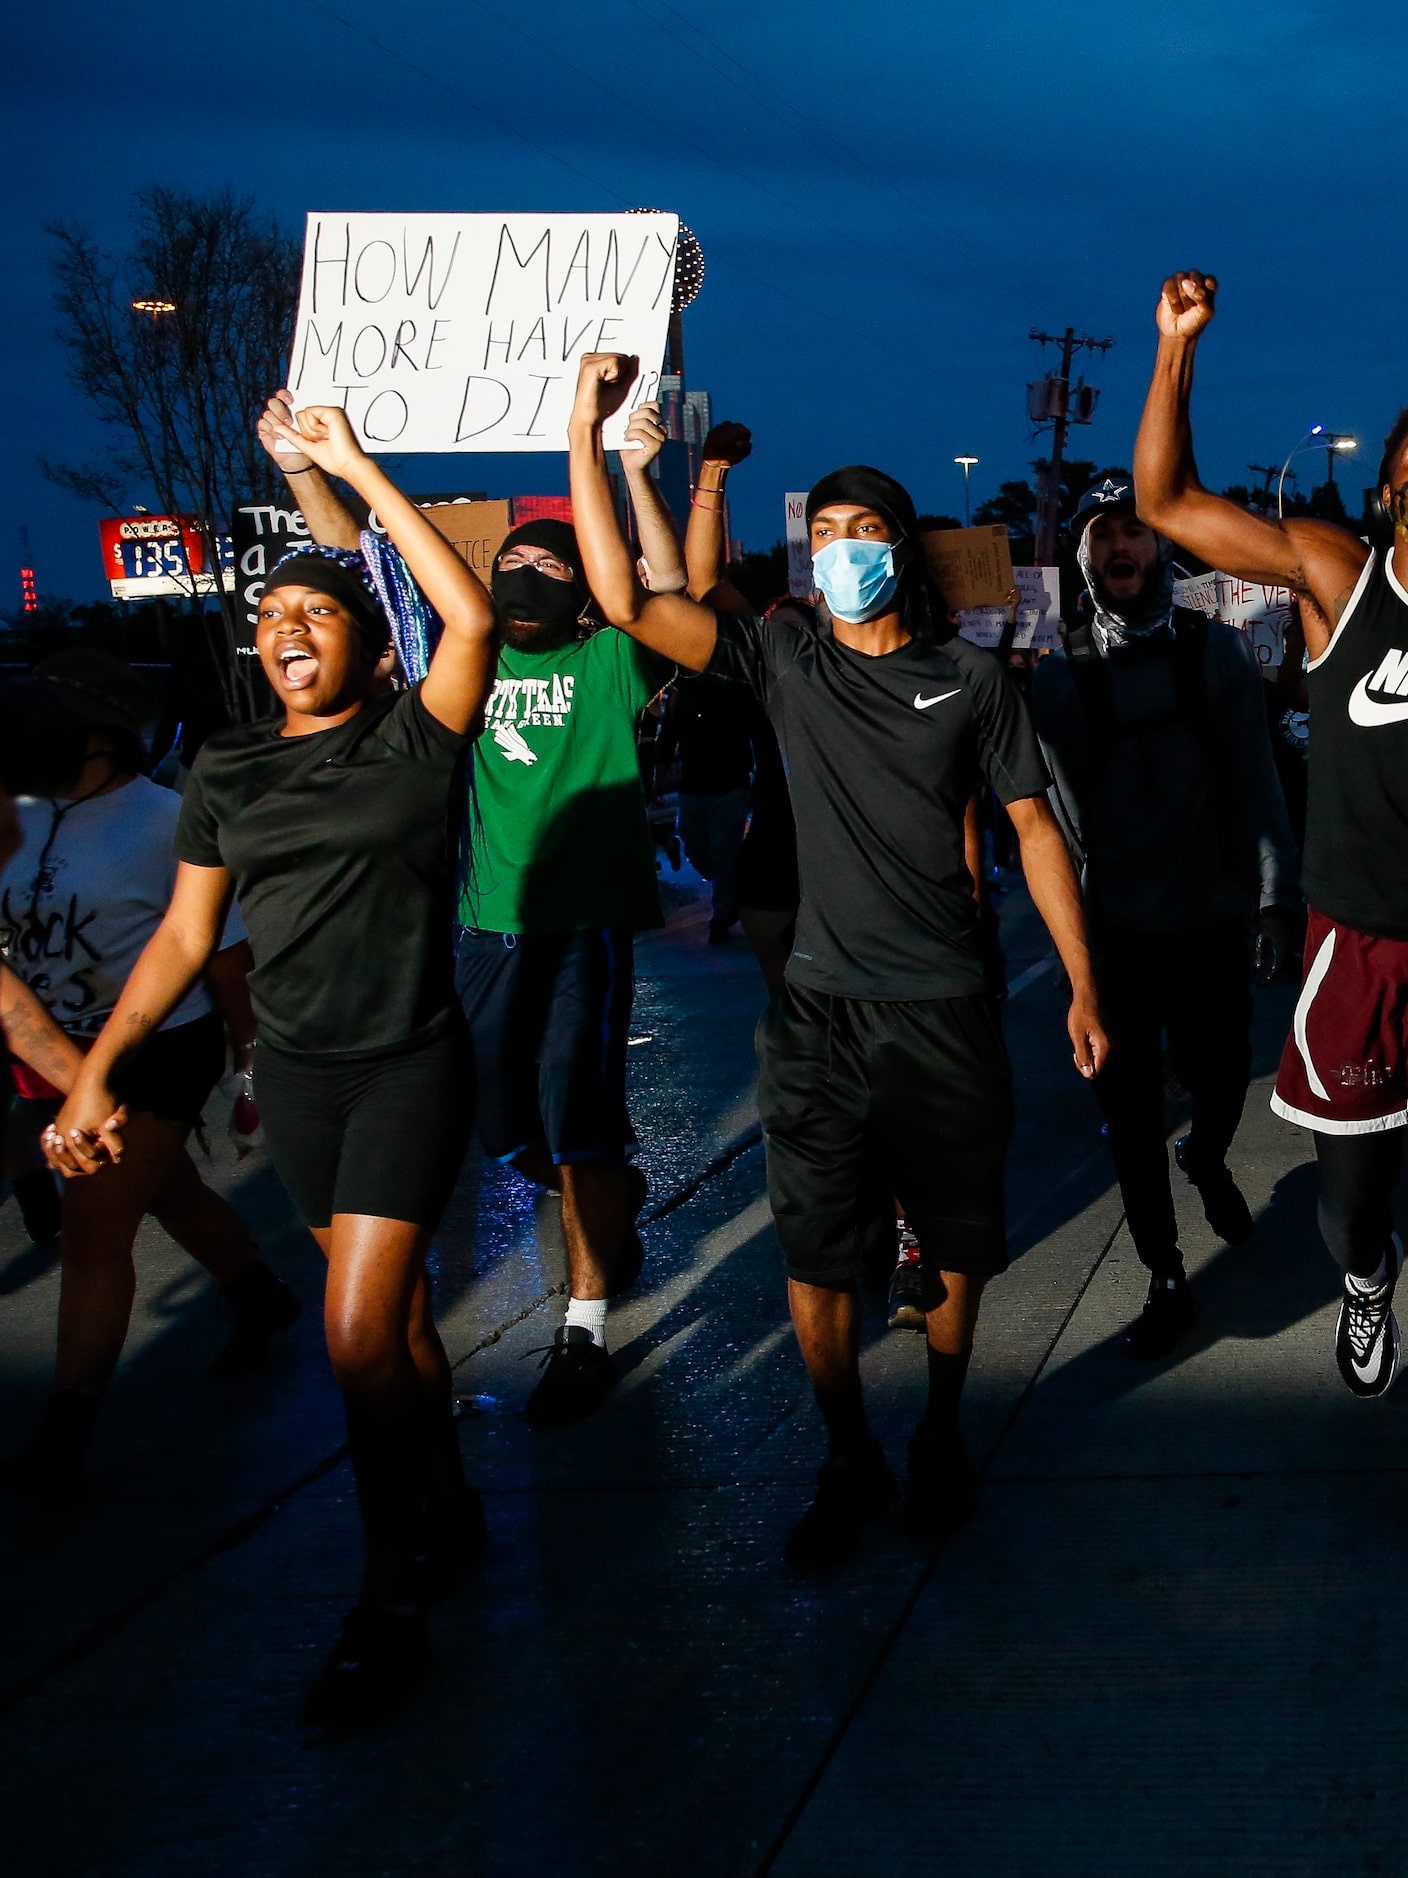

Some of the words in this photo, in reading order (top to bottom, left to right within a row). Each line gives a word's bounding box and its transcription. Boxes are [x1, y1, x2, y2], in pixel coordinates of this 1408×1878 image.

[313, 222, 461, 314] HOW
[486, 223, 677, 315] MANY
[296, 319, 452, 390] MORE
[484, 316, 624, 370] HAVE
[332, 385, 408, 442] TO
[239, 544, 267, 577] a
[1217, 579, 1254, 606] THE
